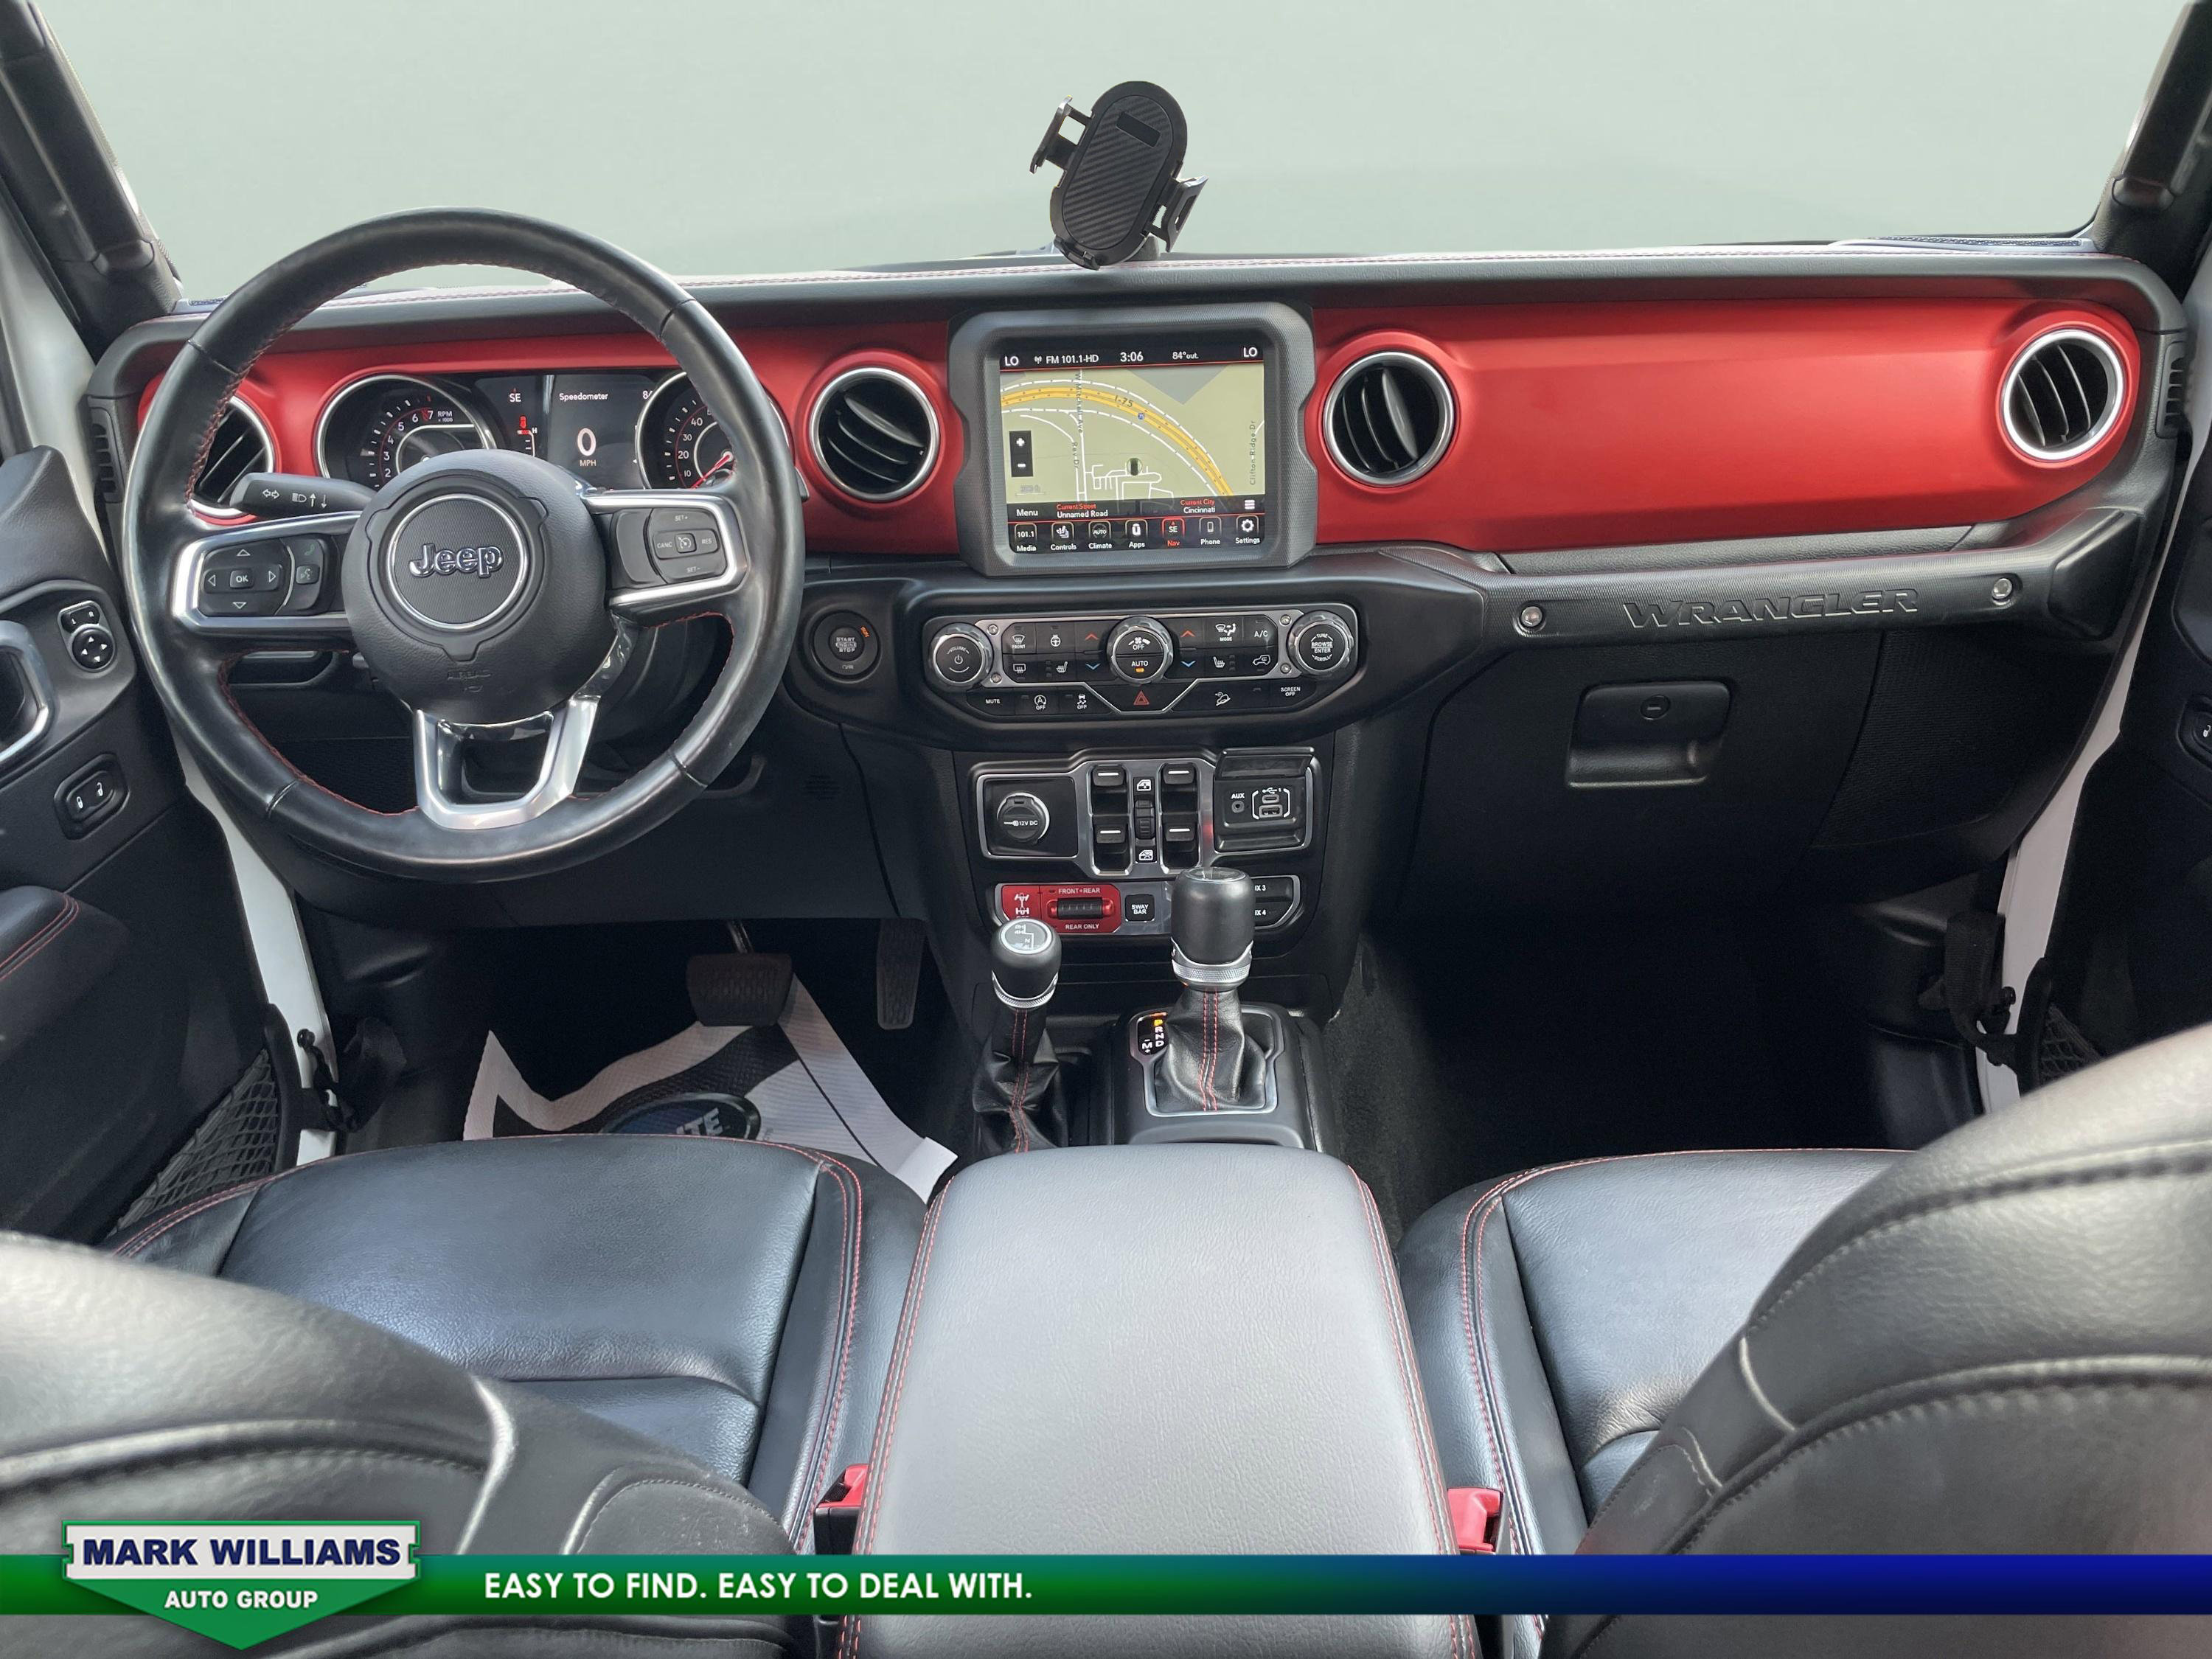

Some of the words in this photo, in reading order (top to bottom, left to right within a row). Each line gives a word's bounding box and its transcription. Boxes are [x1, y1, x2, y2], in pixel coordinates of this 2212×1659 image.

[1120, 351, 1144, 363] 3:06
[1242, 347, 1258, 358] LO
[1005, 356, 1019, 366] LO
[1046, 355, 1060, 364] FM
[1061, 354, 1099, 364] 101.1-HD
[509, 393, 522, 403] SE
[559, 392, 609, 403] Speedometer
[1115, 394, 1133, 408] I-75
[411, 414, 419, 422] 6
[428, 410, 434, 420] 7
[397, 422, 405, 431] 5
[691, 417, 703, 426] 40
[1249, 420, 1256, 430] Dr
[387, 435, 394, 445] 4
[683, 434, 692, 442] 30
[1249, 433, 1257, 456] Ridge
[383, 451, 390, 461] 3
[678, 451, 689, 459] 20
[385, 468, 392, 478] 2
[1183, 506, 1216, 514] Cincinnati
[1235, 537, 1260, 545] Settings
[408, 543, 504, 578] Jeep
[235, 574, 248, 583] OK
[1622, 588, 1918, 628] WRANGLER
[1155, 1032, 1164, 1040] N
[1141, 1041, 1153, 1049] M
